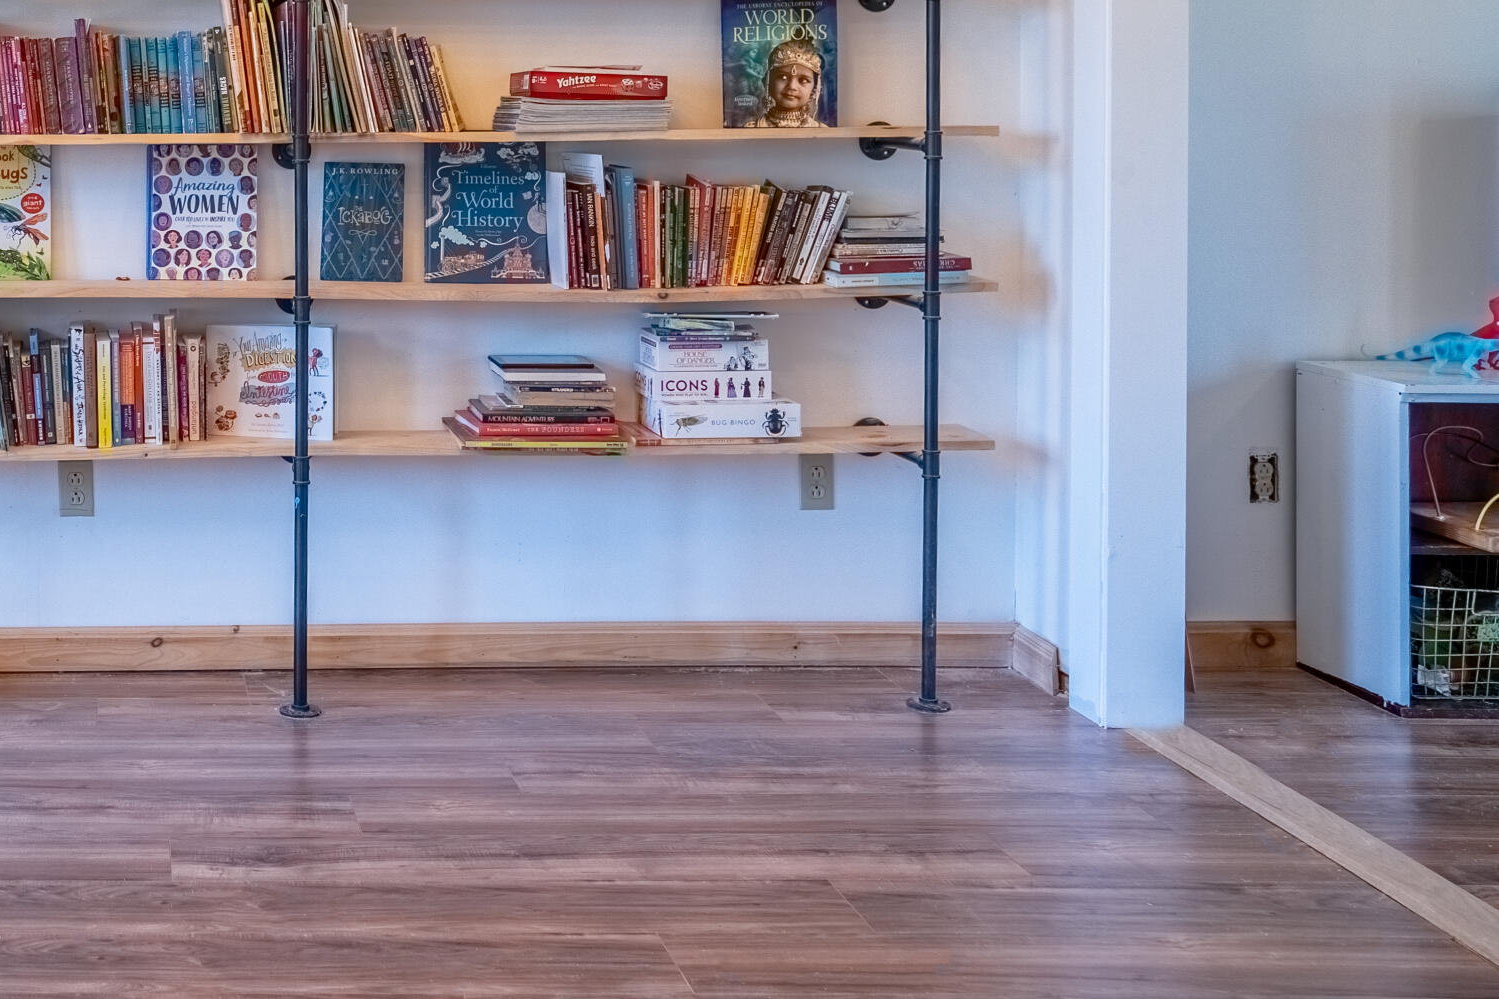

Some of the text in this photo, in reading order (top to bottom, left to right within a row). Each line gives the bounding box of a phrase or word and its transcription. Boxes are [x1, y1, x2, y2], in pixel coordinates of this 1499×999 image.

[745, 8, 815, 25] WORLD
[733, 24, 828, 44] RELIGIONS
[556, 75, 597, 89] Yahtzee
[219, 76, 232, 126] SURVIVAL HACKS
[350, 167, 399, 175] ROWLING
[451, 169, 525, 185] Timelines
[171, 176, 236, 198] Amazing
[488, 185, 499, 194] of
[168, 193, 239, 216] WOMEN
[455, 189, 514, 209] World
[586, 193, 594, 204] IAN
[451, 207, 524, 233] History
[587, 204, 595, 227] RANKIN
[246, 351, 297, 367] DIGESTION
[259, 371, 289, 381] MOUTH
[660, 379, 708, 392] ICONS
[488, 415, 556, 423] MOUNTAIN ADVENTURE
